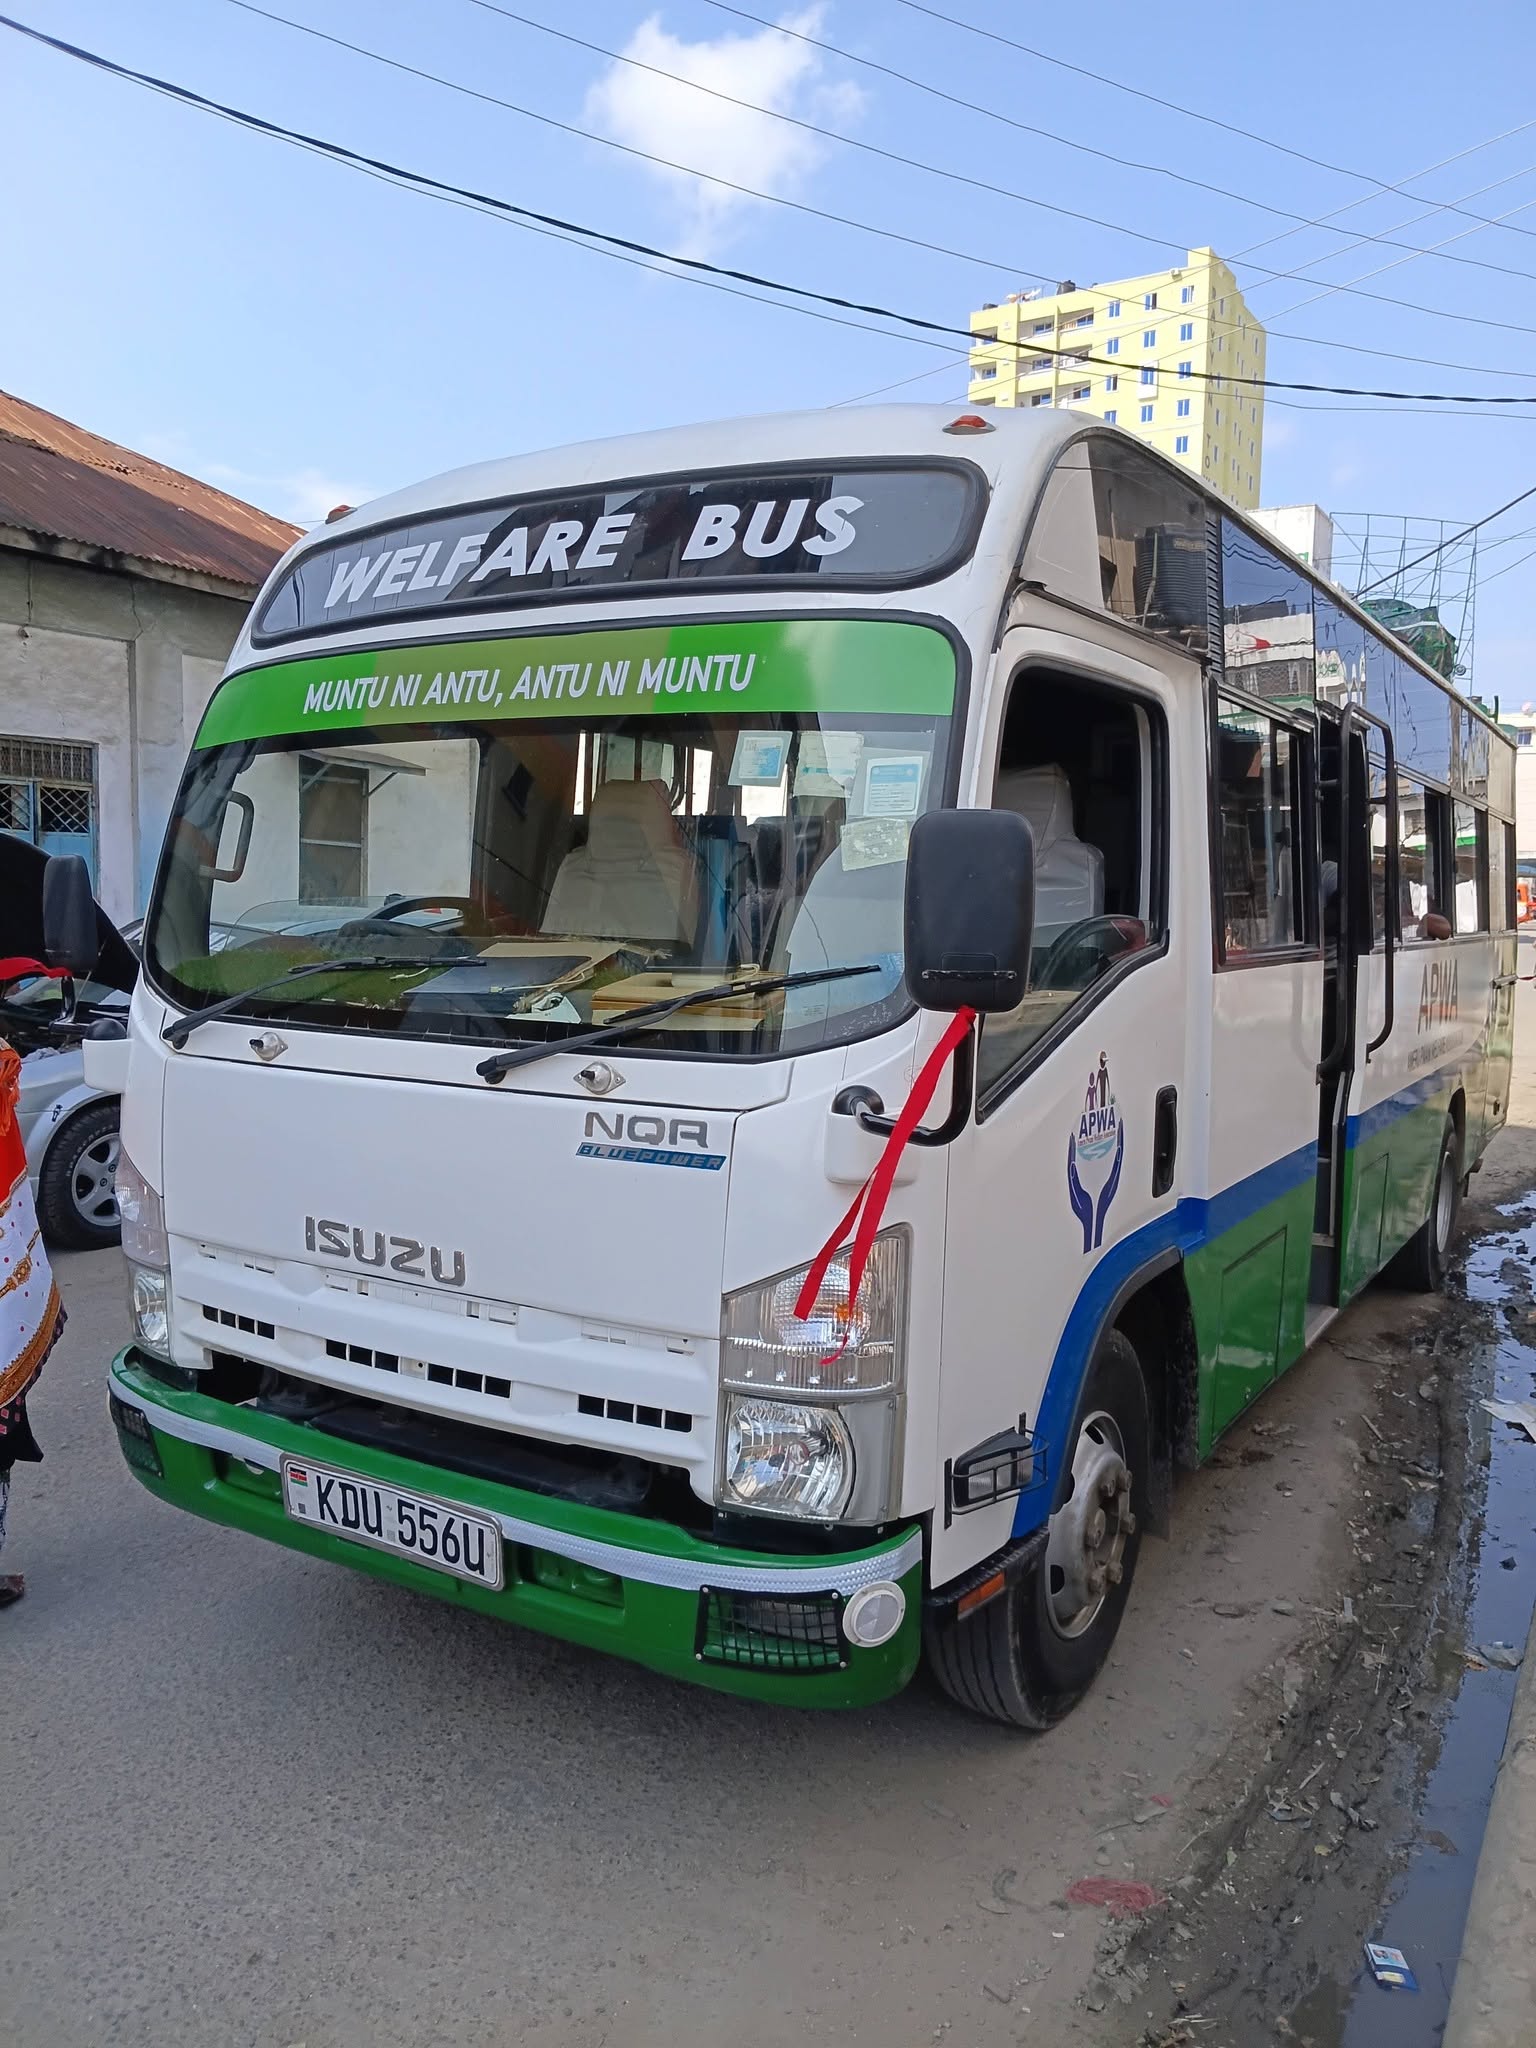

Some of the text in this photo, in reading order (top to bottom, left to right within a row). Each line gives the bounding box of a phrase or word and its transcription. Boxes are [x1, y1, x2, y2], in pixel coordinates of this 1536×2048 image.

[323, 496, 864, 608] WELFARE BUS
[303, 654, 756, 714] MUNTU NI ANTU, ANTU NI MUNTU
[1417, 959, 1458, 1035] APWA
[584, 1111, 709, 1149] NQR
[1079, 1106, 1116, 1139] APWA
[578, 1144, 723, 1169] BLUEPOWER
[305, 1216, 466, 1287] ISUZU
[316, 1475, 485, 1576] KDU 556U
